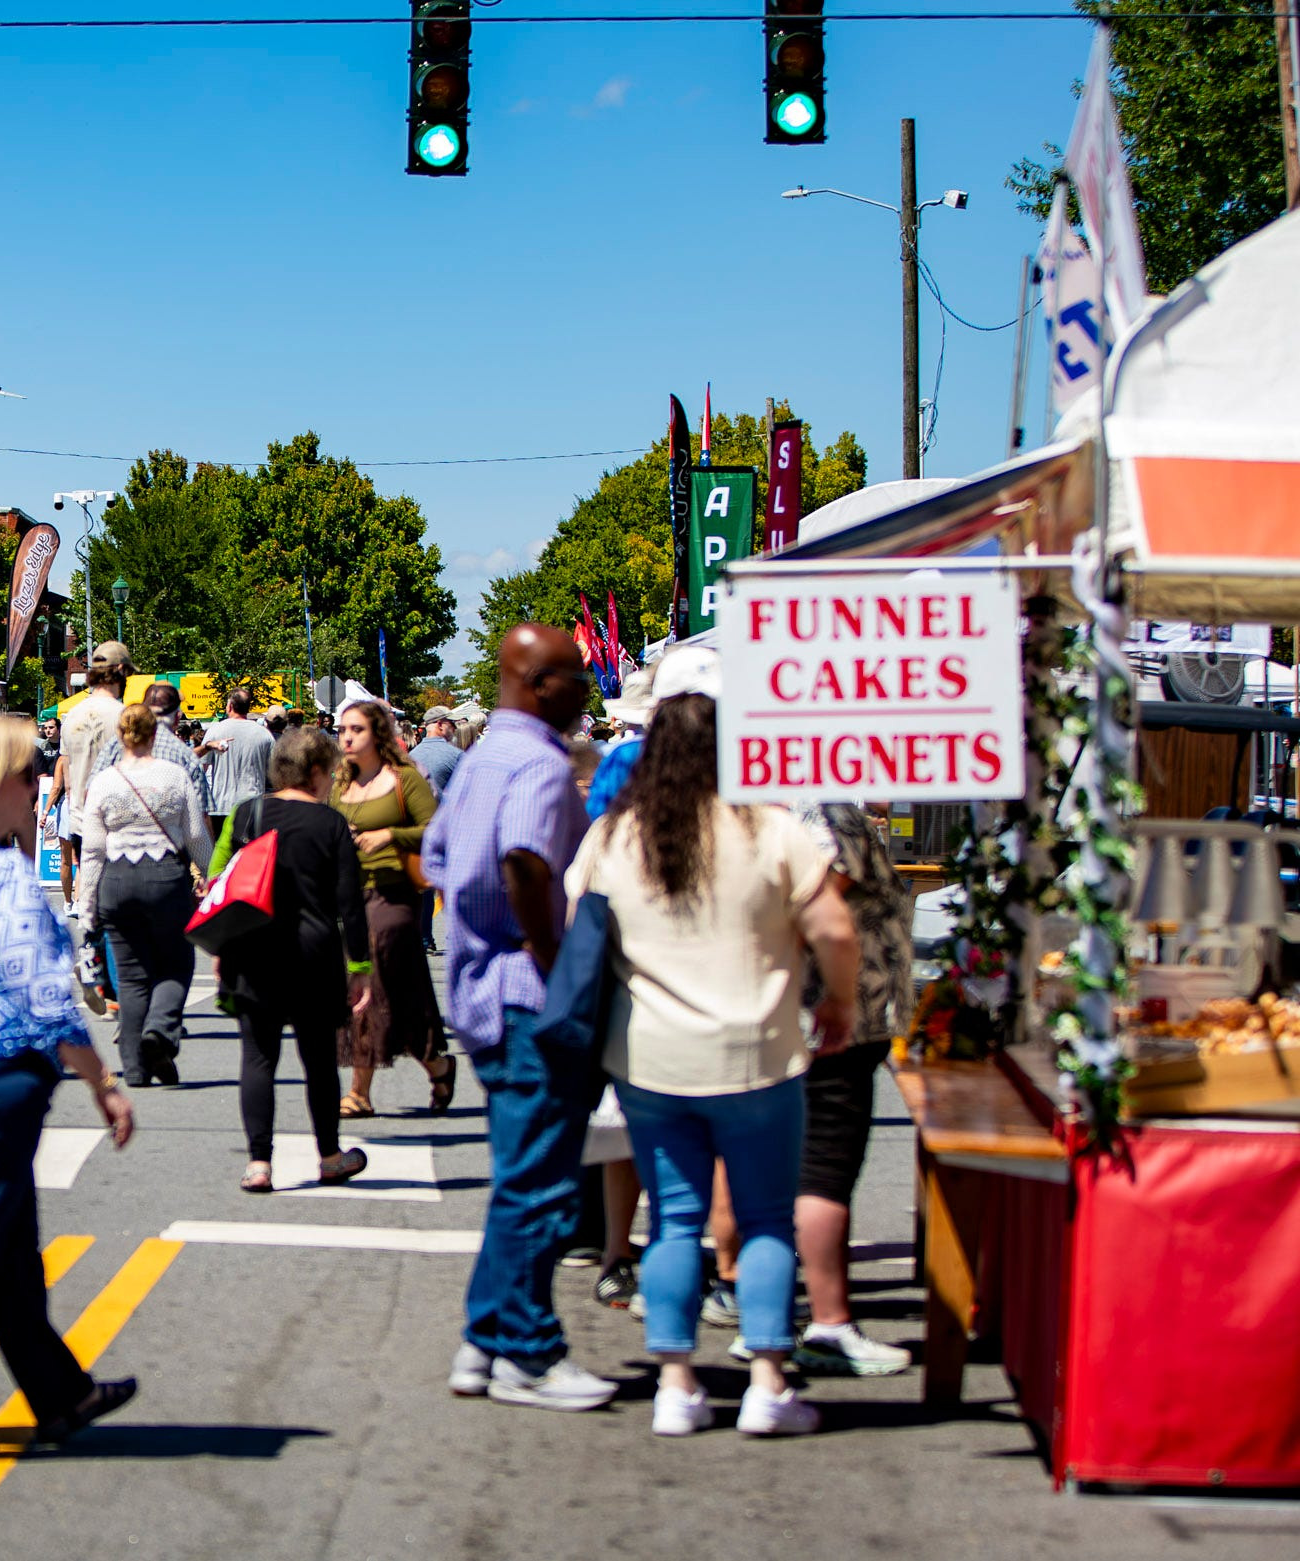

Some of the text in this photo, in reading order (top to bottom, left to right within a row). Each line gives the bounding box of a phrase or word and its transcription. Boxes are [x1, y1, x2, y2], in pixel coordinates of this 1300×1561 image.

[12, 533, 51, 616] Lazer Edge
[748, 594, 988, 641] FUNNEL
[770, 656, 968, 702] CAKES
[740, 731, 1002, 788] BEIGNETS
